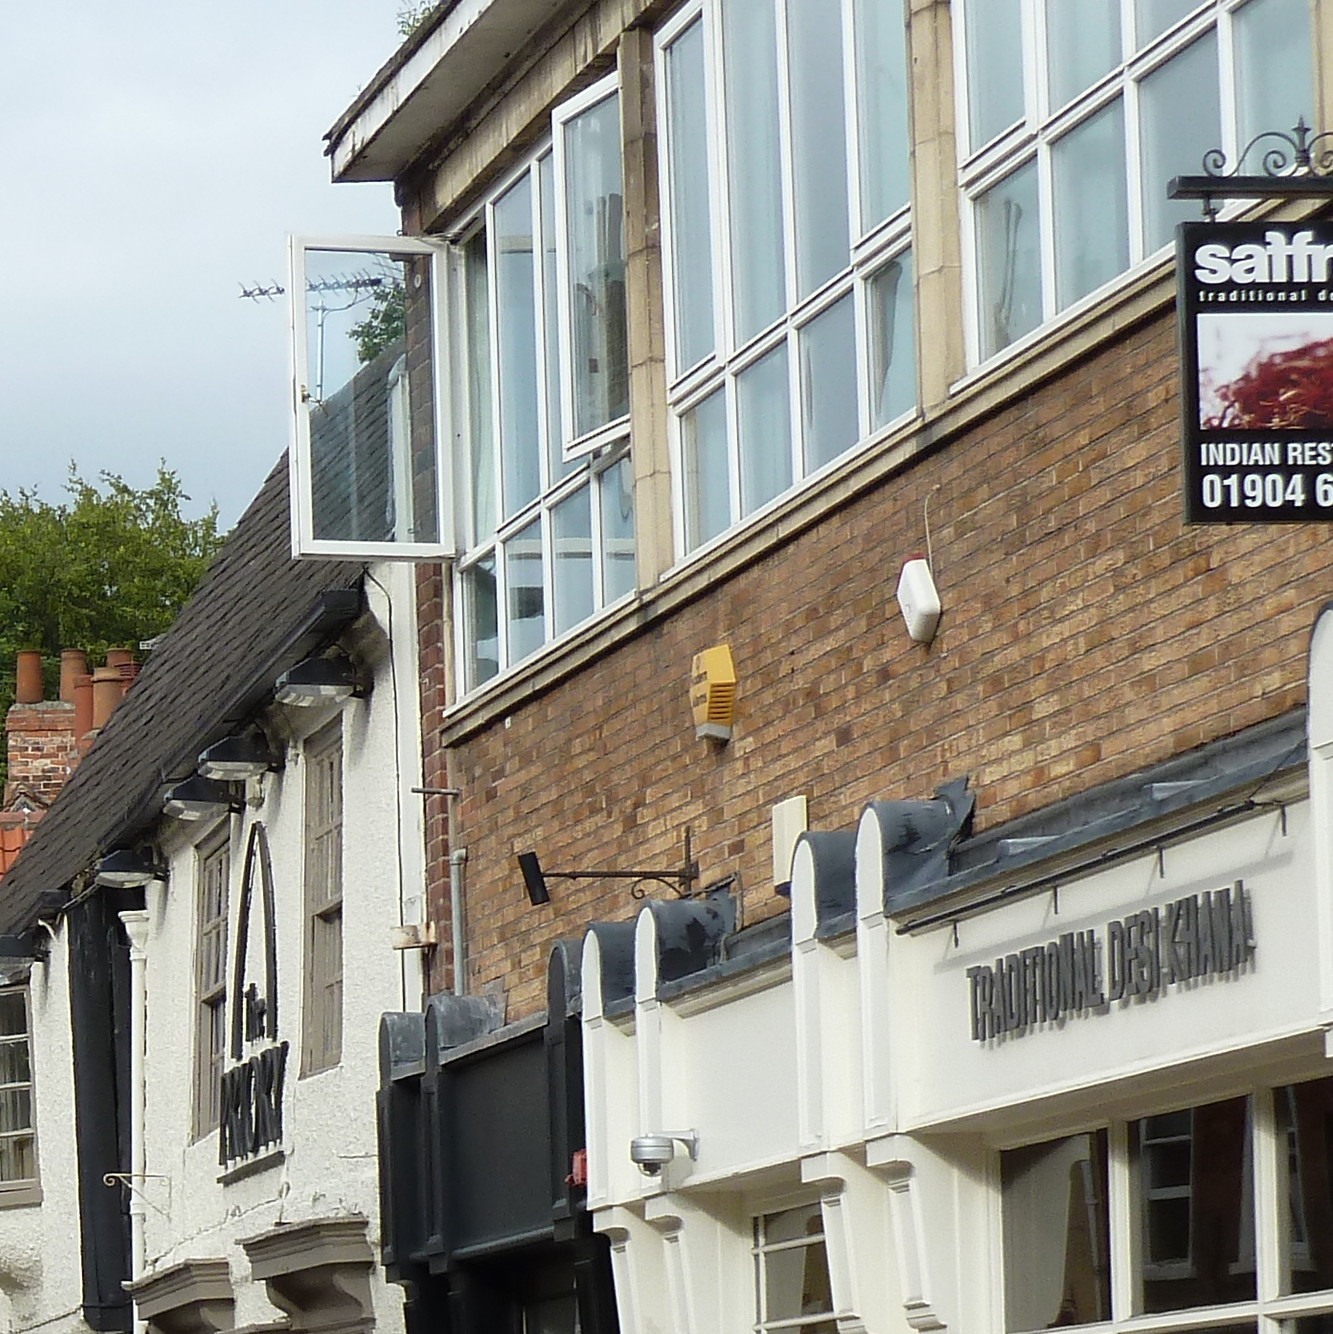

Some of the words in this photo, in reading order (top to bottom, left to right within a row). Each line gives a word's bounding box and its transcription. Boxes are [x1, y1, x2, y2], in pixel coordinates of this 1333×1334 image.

[1199, 289, 1306, 301] traditional
[1200, 443, 1279, 466] INDIAN
[1287, 443, 1333, 465] RES
[1202, 473, 1305, 508] 01904
[965, 929, 1104, 1042] TRADITIONAL
[1107, 907, 1160, 1000] DESI
